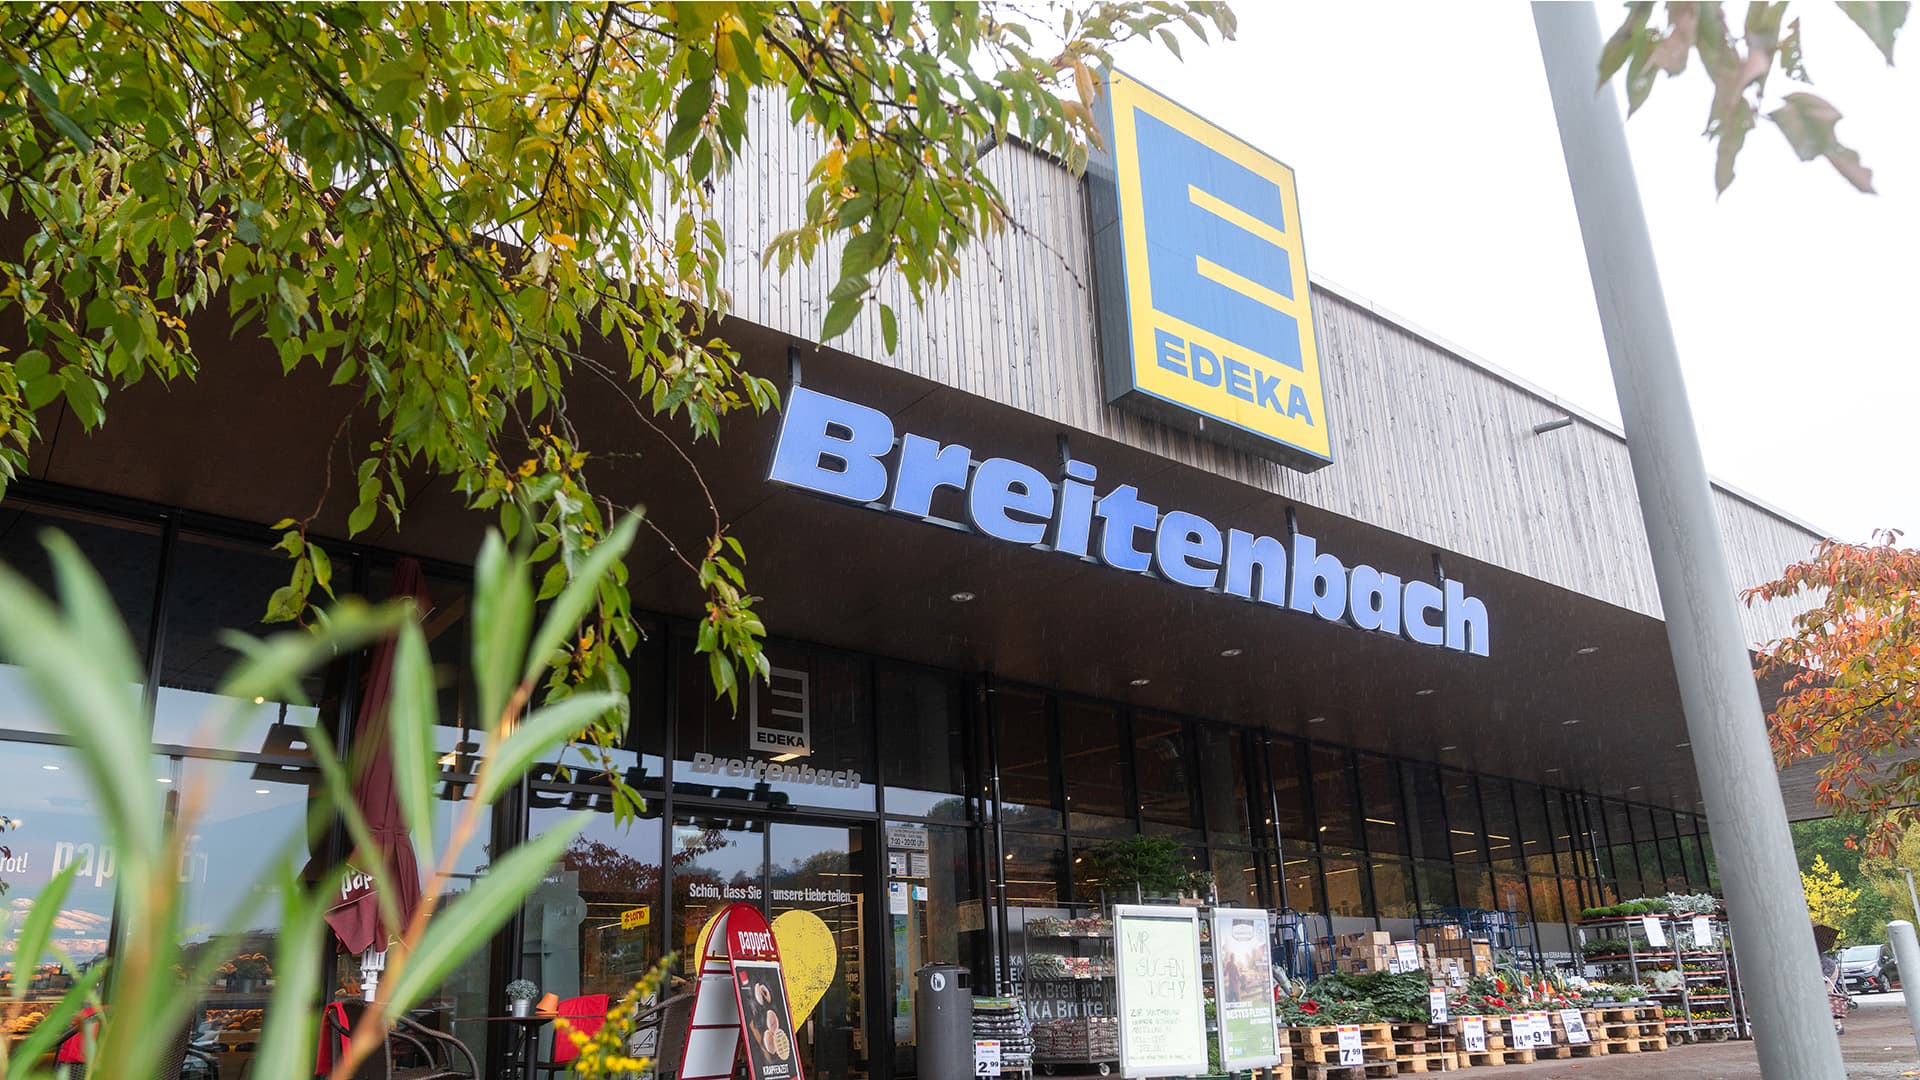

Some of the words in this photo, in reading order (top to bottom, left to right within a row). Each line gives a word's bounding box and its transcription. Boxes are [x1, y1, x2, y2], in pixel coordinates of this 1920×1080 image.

[1154, 327, 1314, 426] EDEKA
[768, 386, 1489, 657] Breitenbach
[757, 732, 805, 748] EDEKA
[691, 753, 862, 790] Breitenbach
[689, 883, 721, 901] Schön,
[723, 885, 746, 900] dass
[747, 886, 762, 900] Sie
[772, 889, 804, 902] unsere
[804, 888, 827, 902] Liebe
[827, 889, 853, 904] teilen.
[737, 928, 775, 957] pappert
[978, 1060, 999, 1074] 2.99
[1341, 1048, 1361, 1062] 7.99
